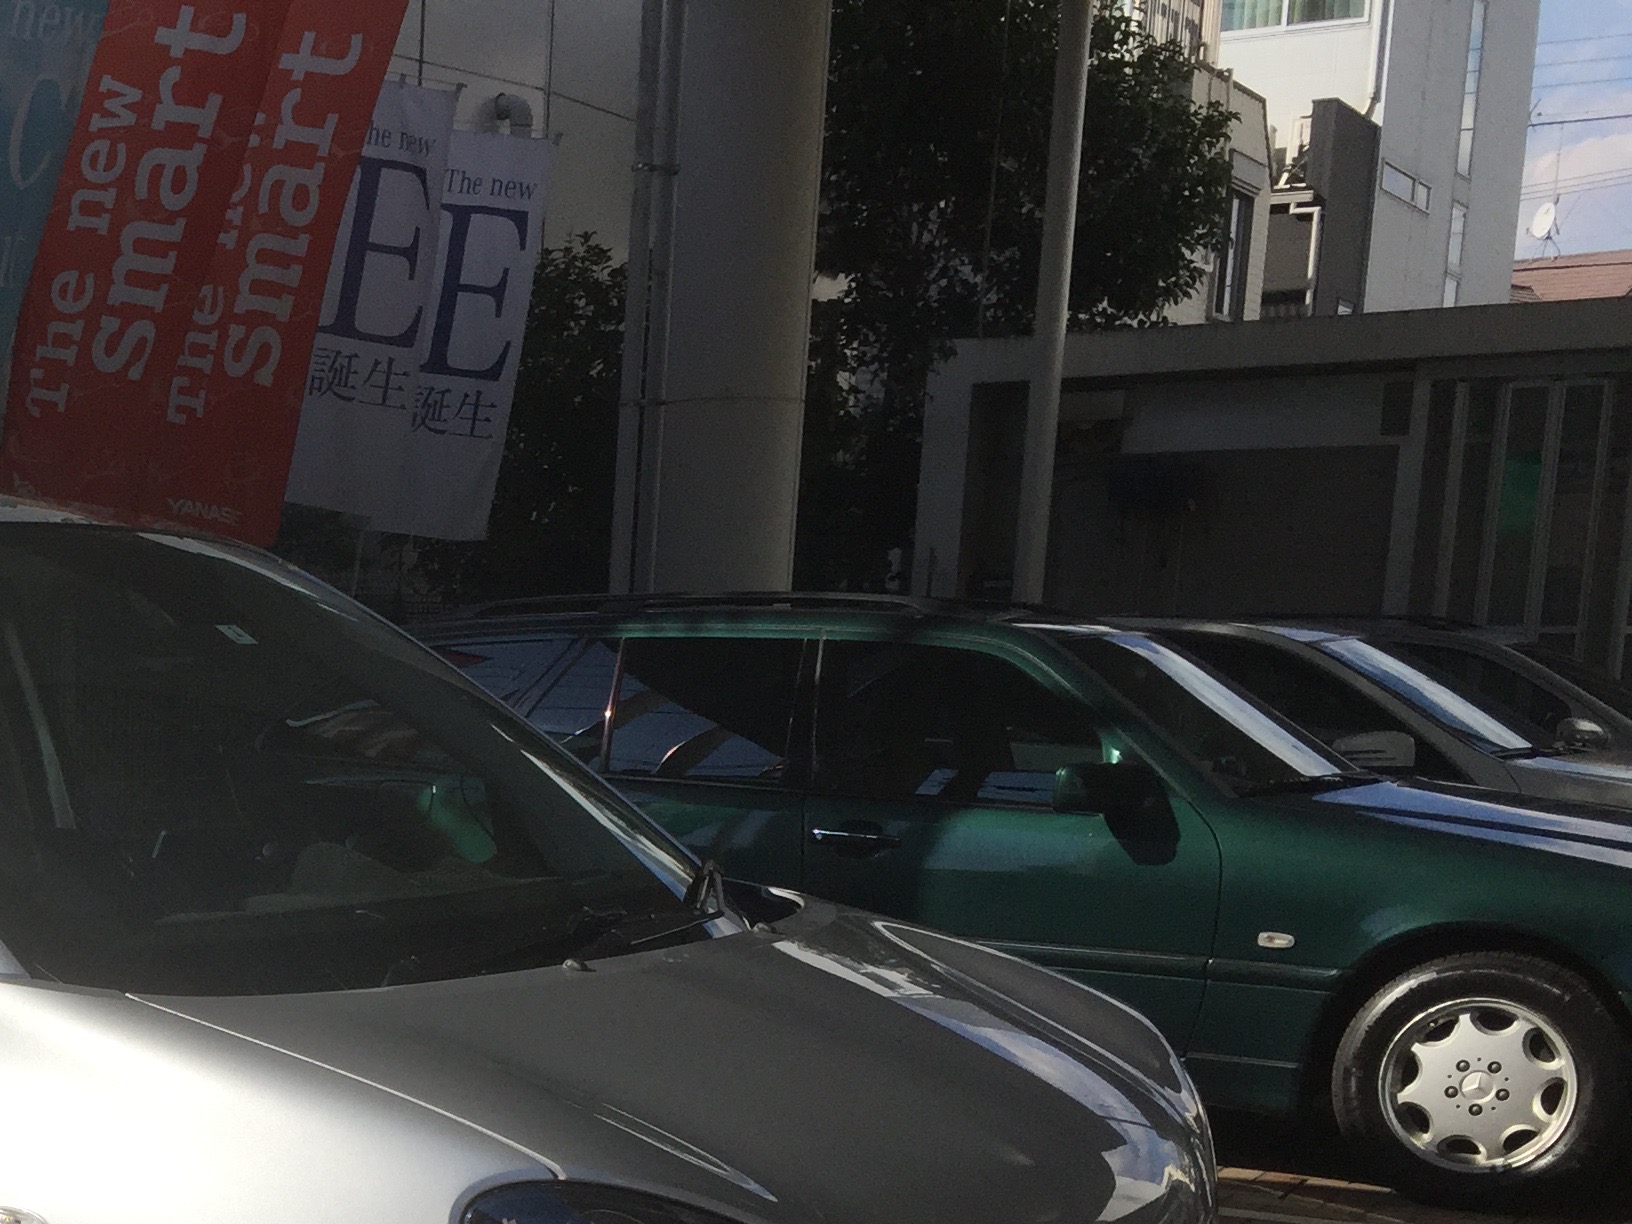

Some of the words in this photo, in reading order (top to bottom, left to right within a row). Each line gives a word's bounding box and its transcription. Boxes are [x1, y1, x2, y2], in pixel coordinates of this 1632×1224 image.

[92, 5, 247, 381] smart
[224, 31, 363, 387] smart
[366, 120, 392, 148] he
[399, 131, 437, 157] new
[443, 168, 484, 196] The
[489, 177, 538, 200] new
[26, 268, 94, 418] The
[68, 73, 144, 235] new
[318, 156, 430, 350] E
[420, 203, 529, 381] E
[166, 284, 224, 424] The
[308, 347, 410, 412] 誕生
[411, 385, 498, 441] 誕生
